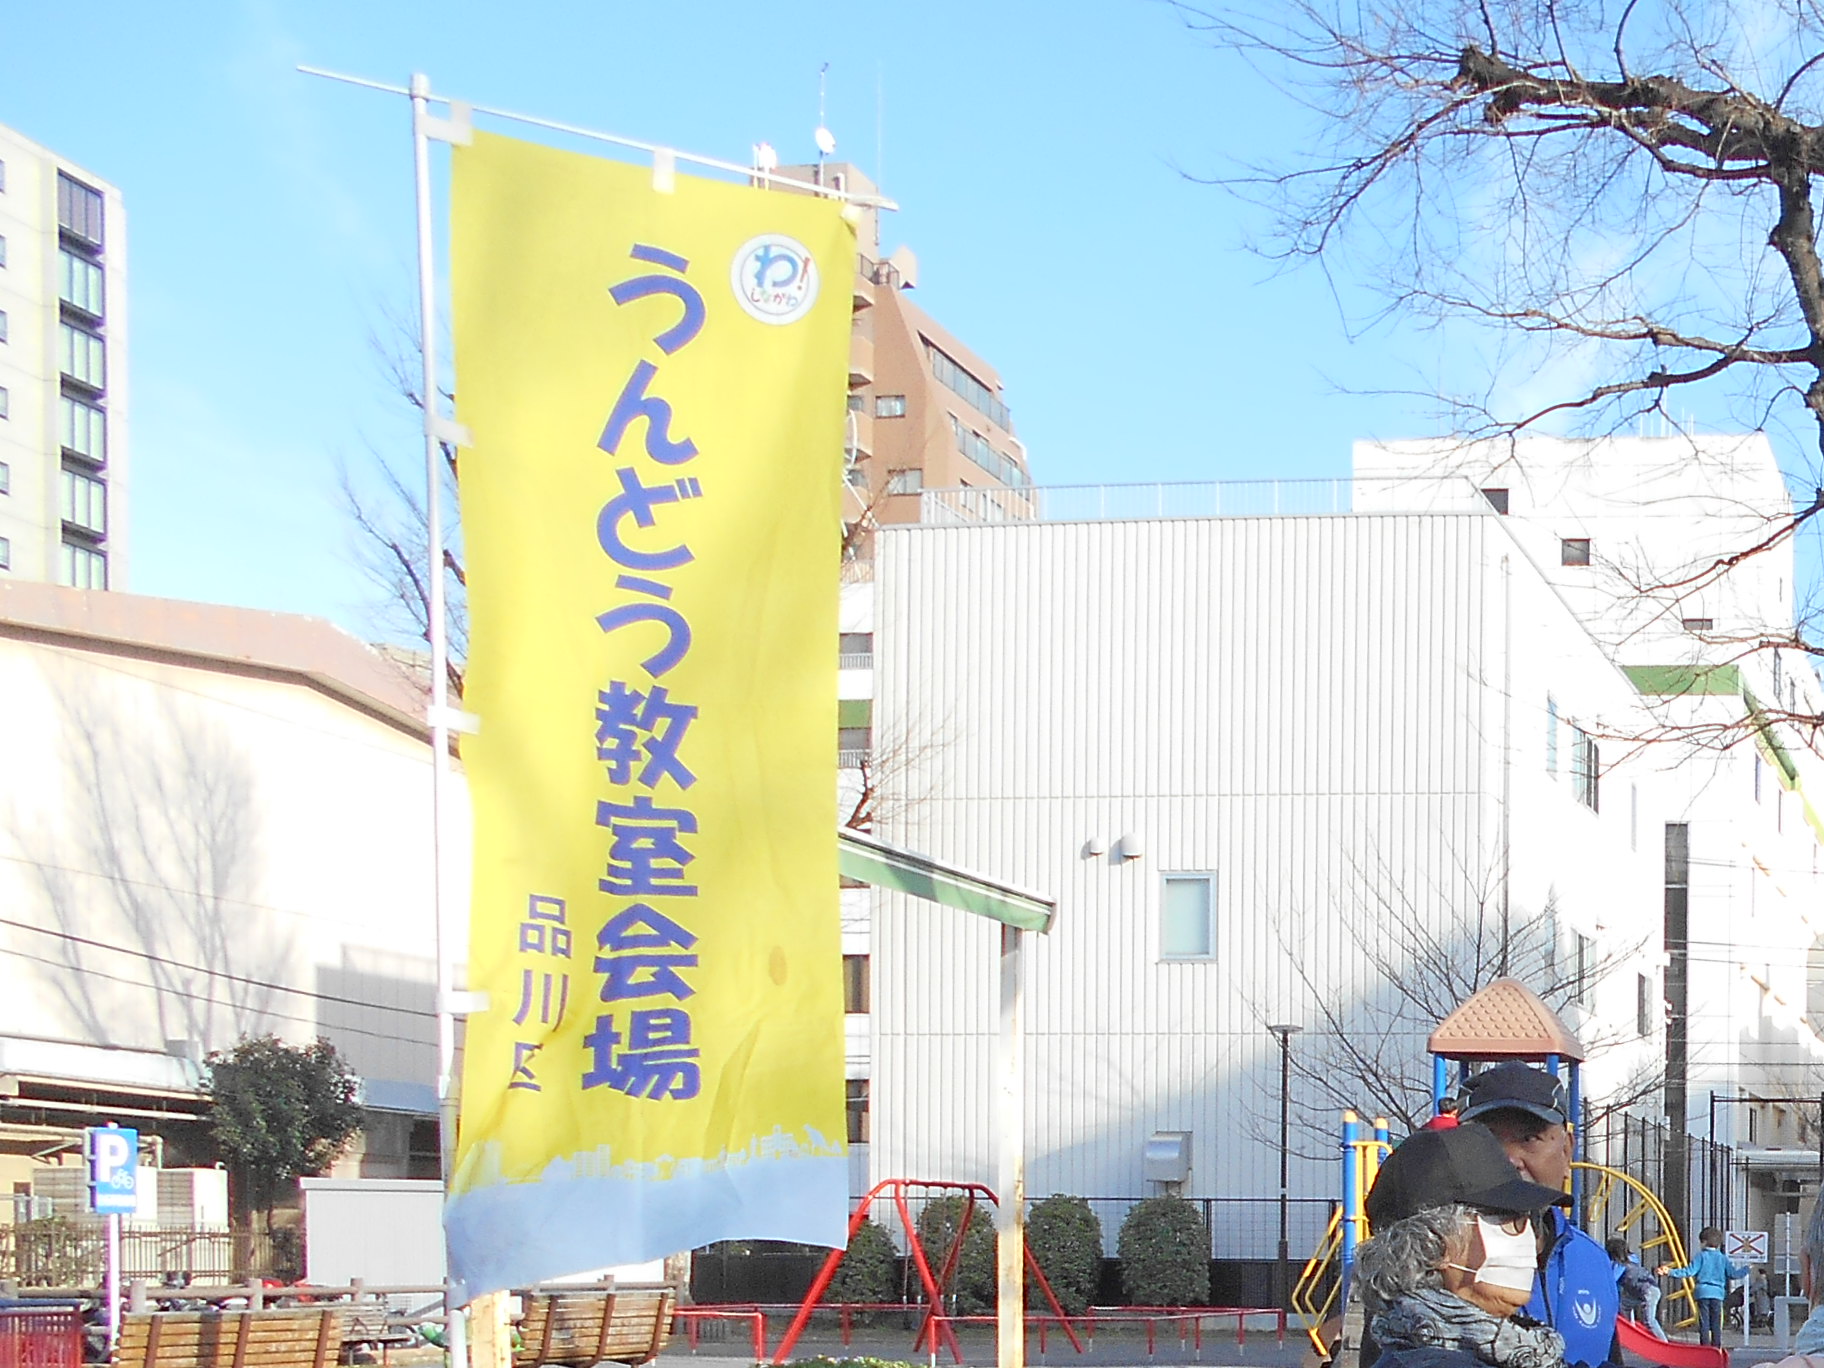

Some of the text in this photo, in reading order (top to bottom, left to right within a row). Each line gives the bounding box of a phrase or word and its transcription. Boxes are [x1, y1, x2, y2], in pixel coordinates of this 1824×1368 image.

[581, 242, 706, 1101] うんどう教室会場
[100, 1134, 129, 1183] P
